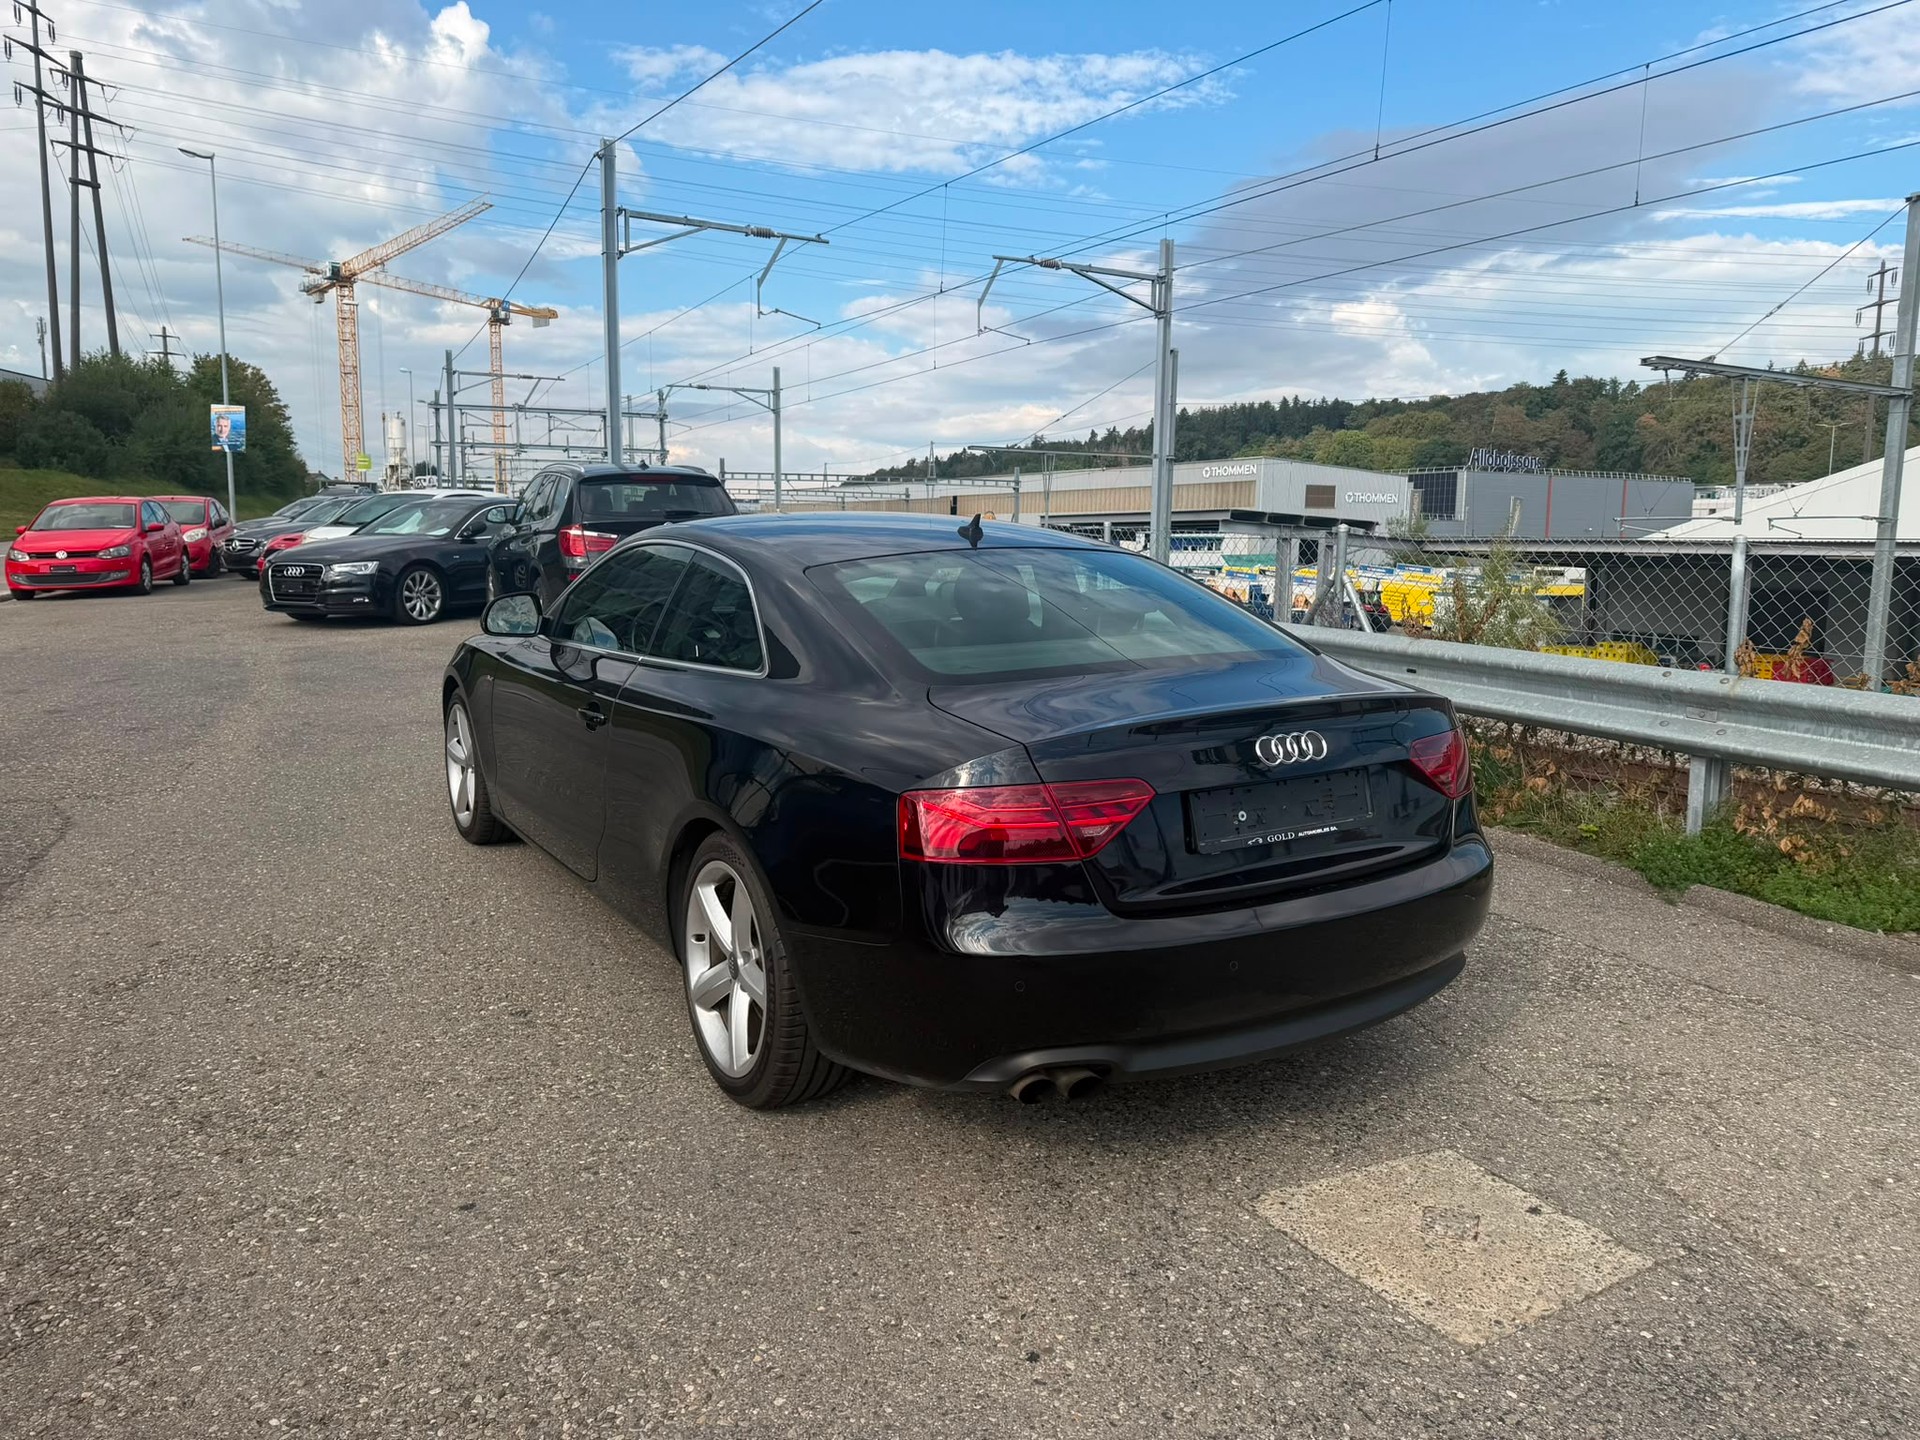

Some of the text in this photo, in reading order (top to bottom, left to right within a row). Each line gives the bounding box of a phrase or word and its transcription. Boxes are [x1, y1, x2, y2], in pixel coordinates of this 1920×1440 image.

[1211, 464, 1257, 477] THOMMEN
[1354, 492, 1399, 503] THOMMEN
[1267, 832, 1295, 843] GOLD
[1298, 827, 1330, 837] AUTOMOBILES
